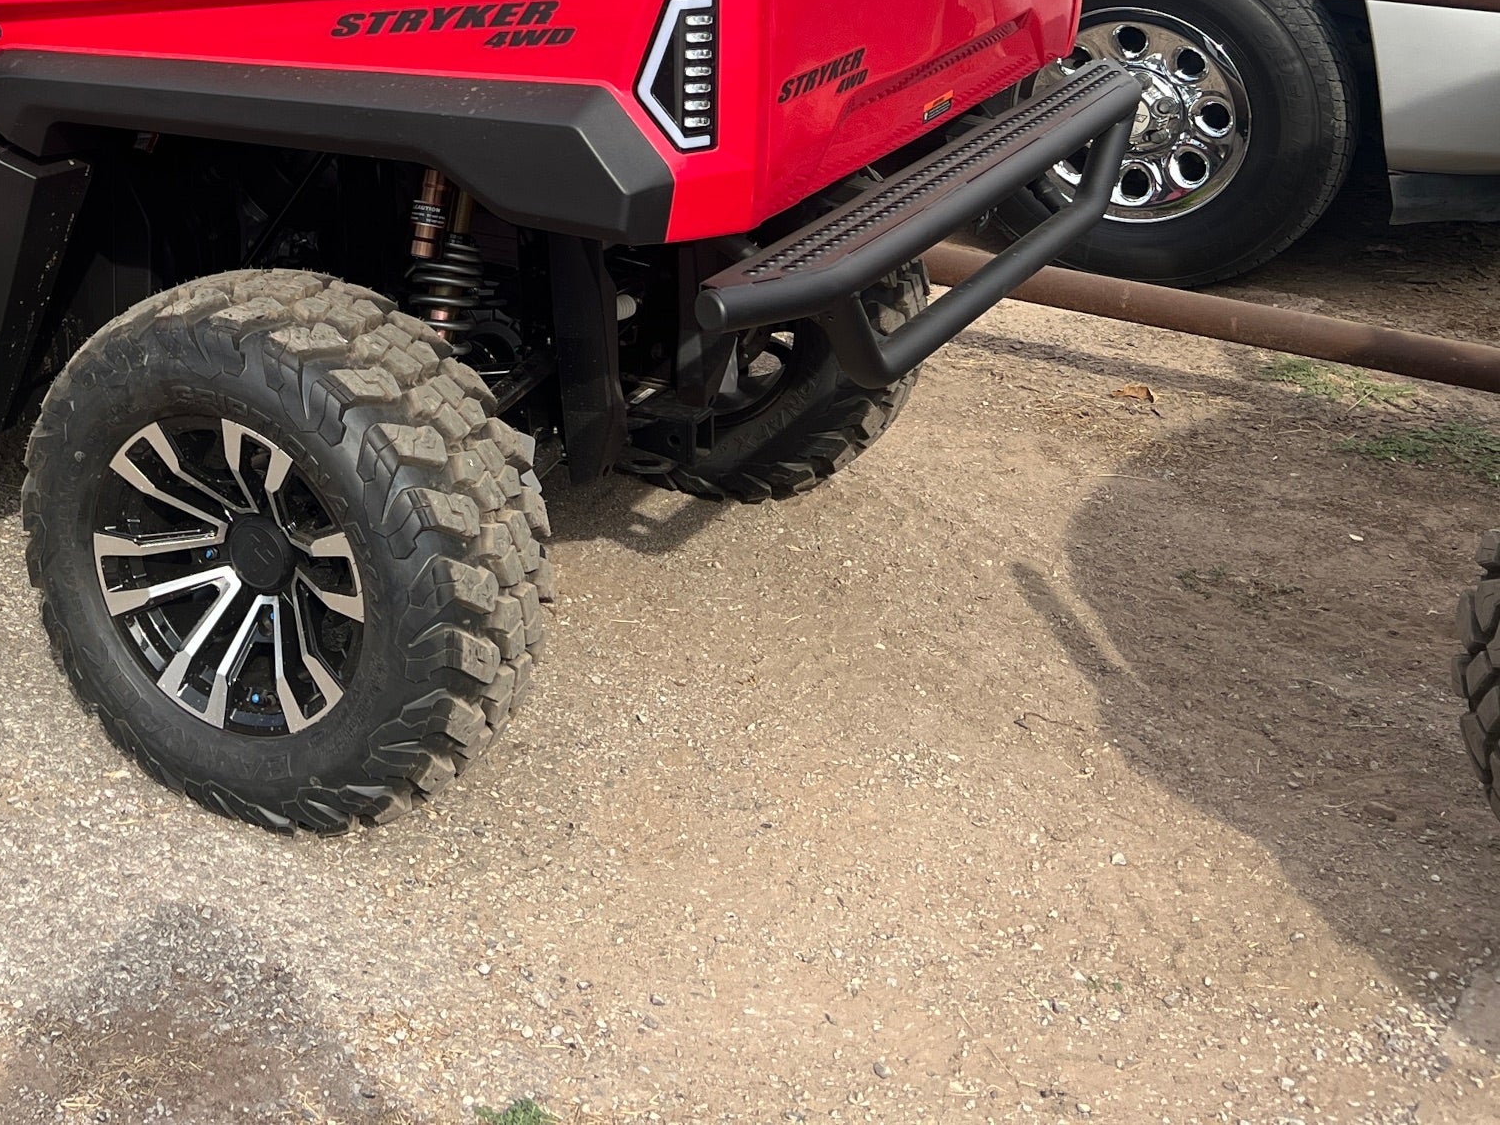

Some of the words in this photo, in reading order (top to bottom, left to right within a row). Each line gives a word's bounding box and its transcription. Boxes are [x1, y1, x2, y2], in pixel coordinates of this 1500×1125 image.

[331, 0, 560, 38] STRYKER
[483, 27, 577, 49] 4WD
[777, 47, 866, 104] STRYKER
[835, 68, 869, 95] 4WD
